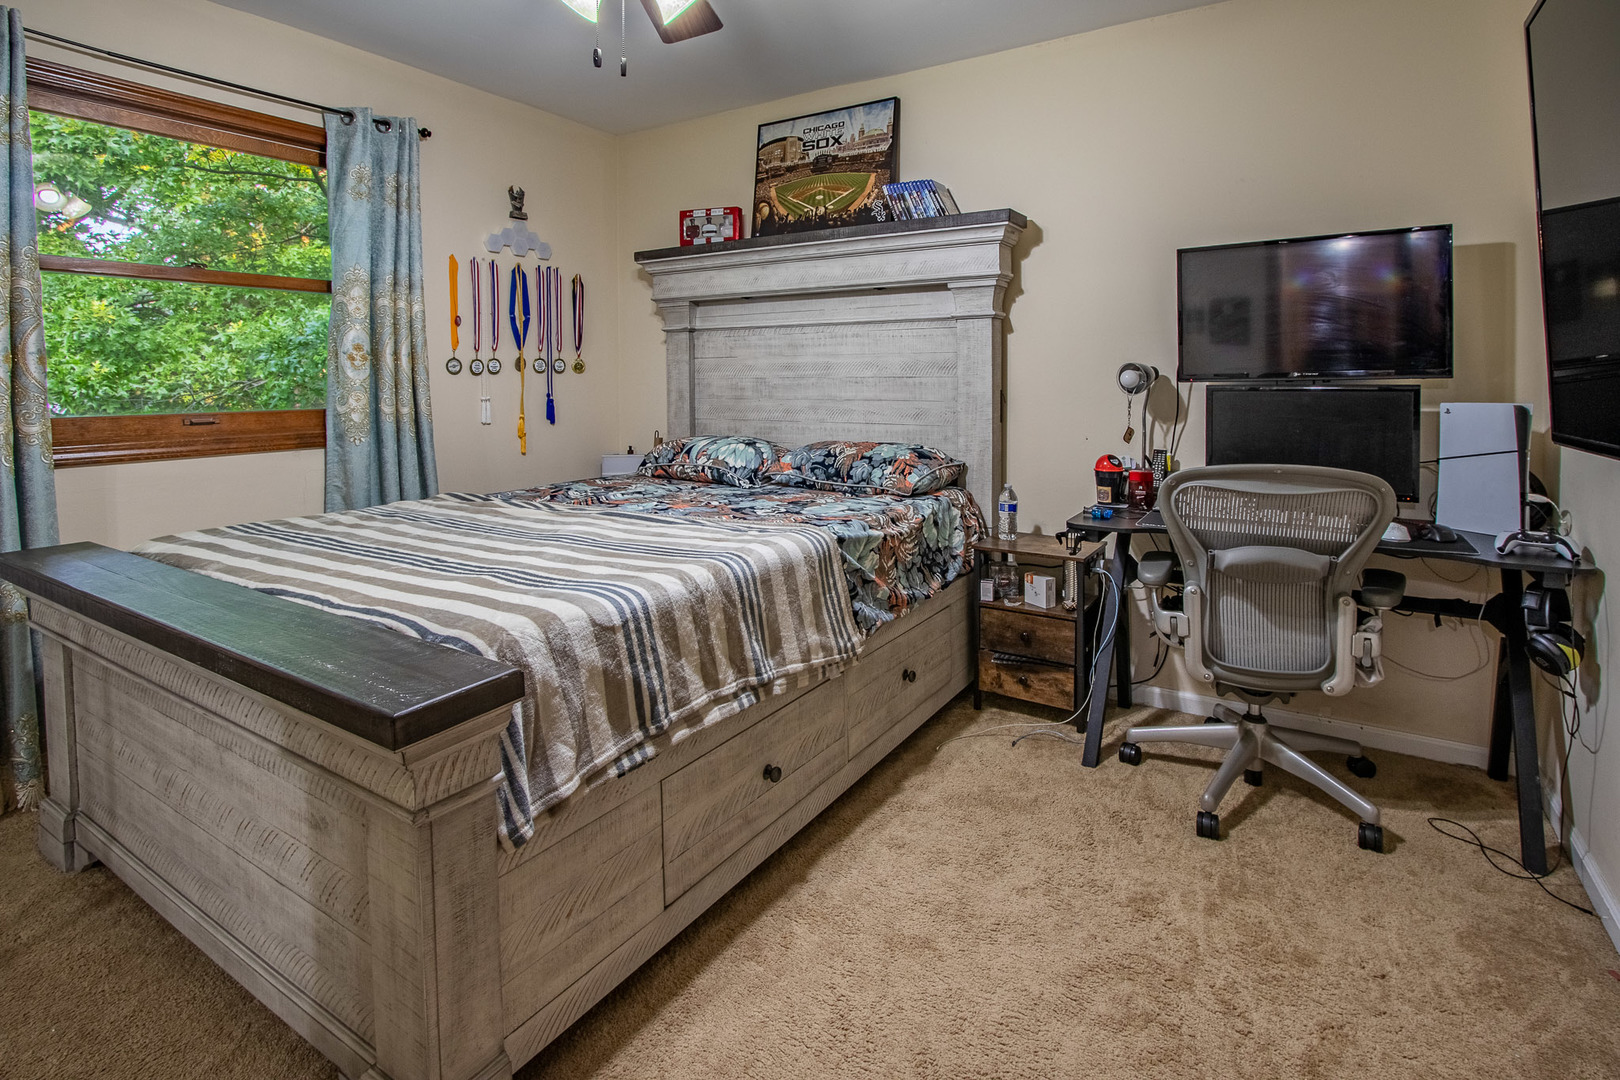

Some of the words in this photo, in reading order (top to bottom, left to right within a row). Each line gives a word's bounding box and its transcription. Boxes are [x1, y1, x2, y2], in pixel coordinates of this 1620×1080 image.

[803, 121, 845, 134] CHICAGO
[803, 127, 844, 140] WHITE
[802, 132, 844, 152] SOX
